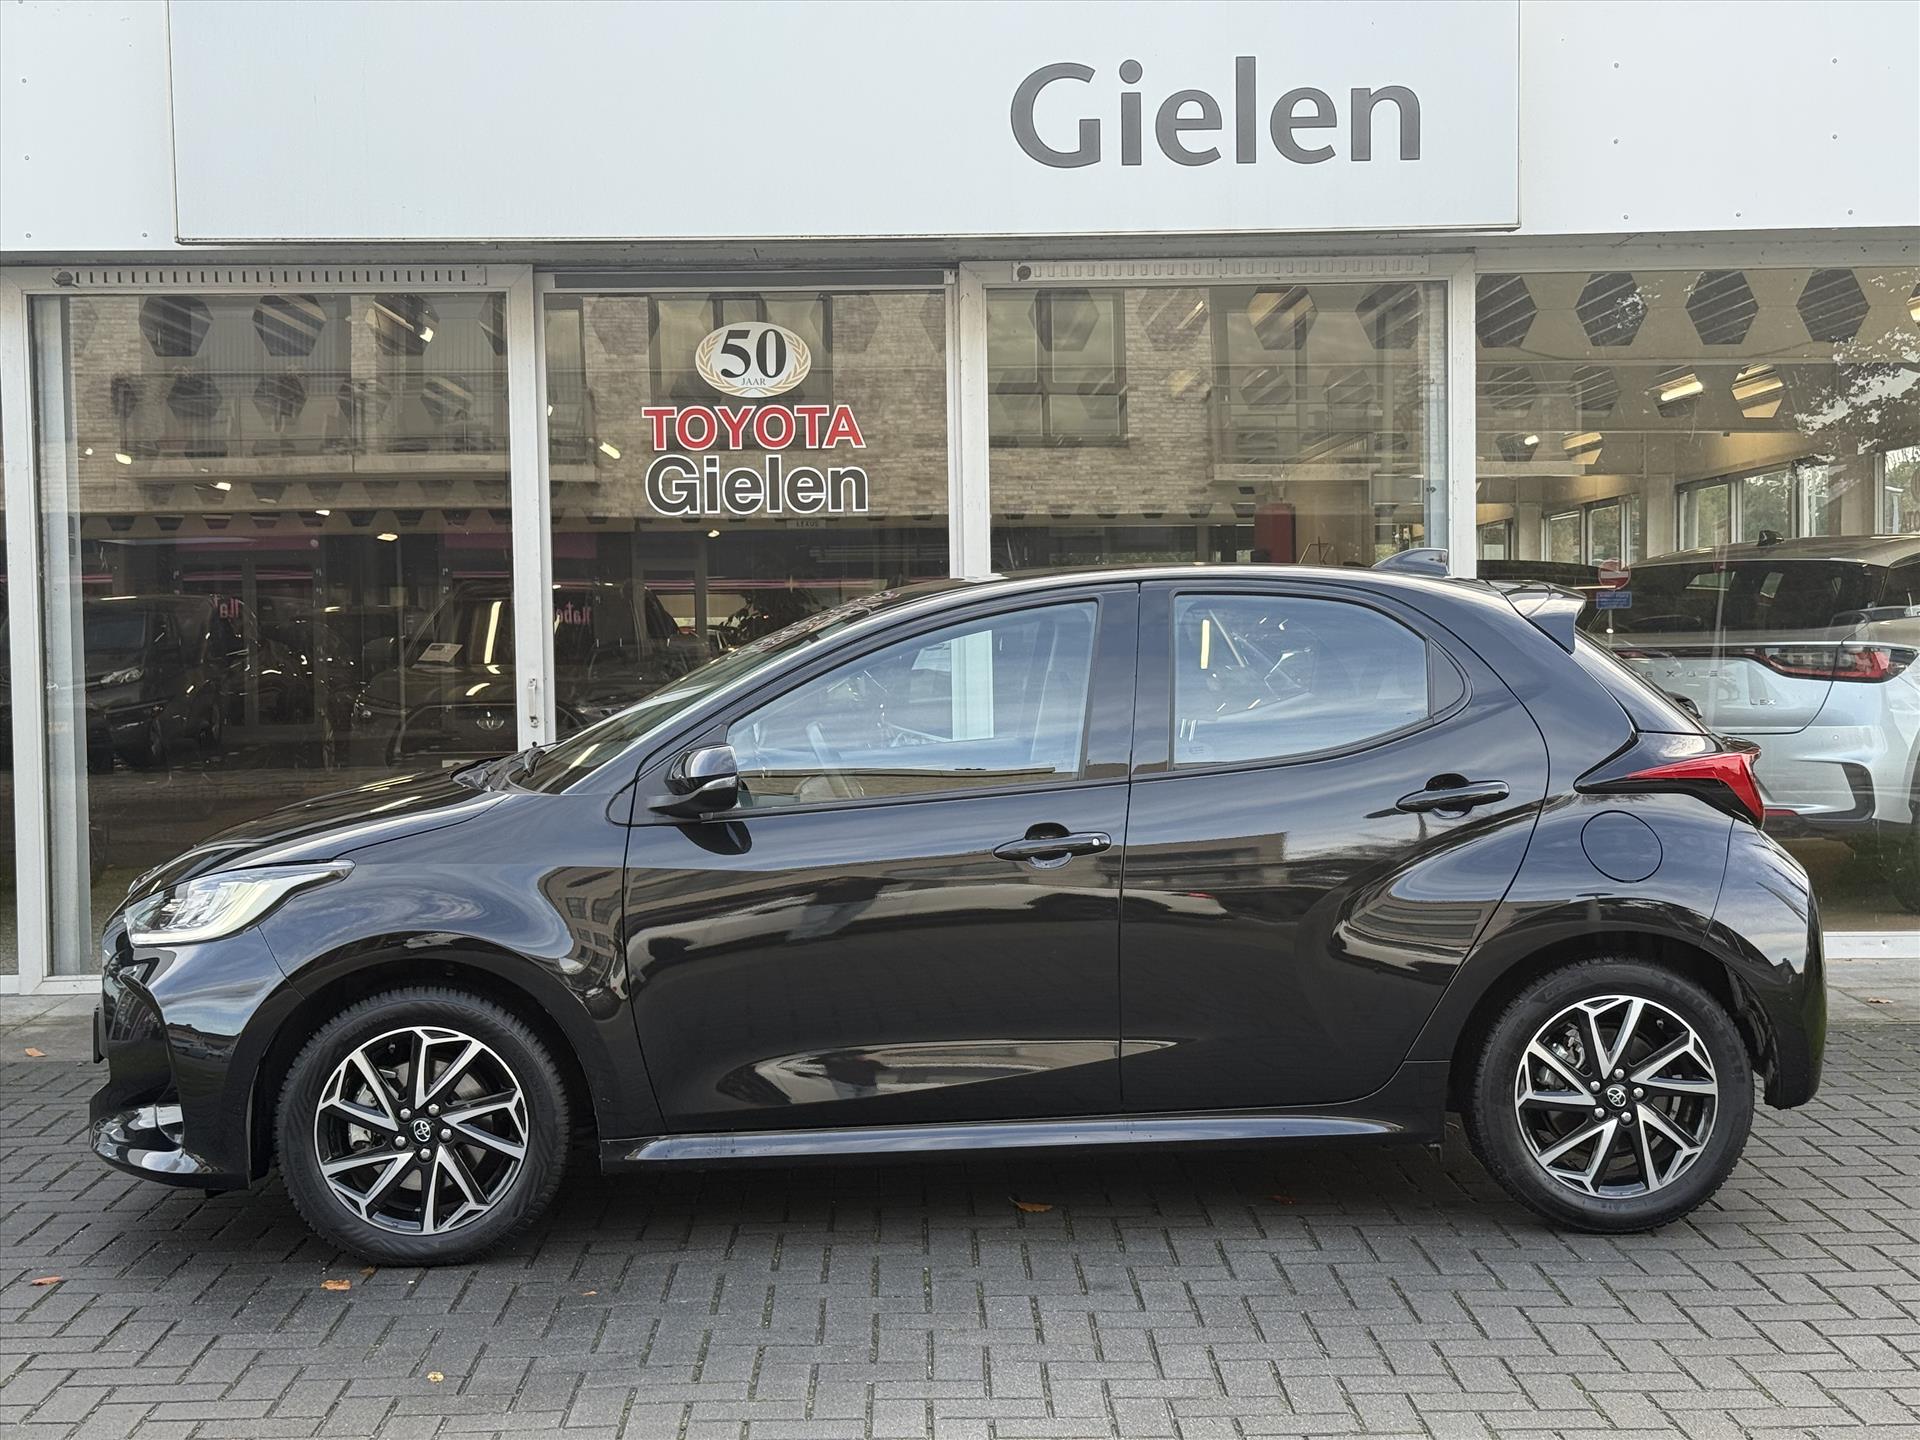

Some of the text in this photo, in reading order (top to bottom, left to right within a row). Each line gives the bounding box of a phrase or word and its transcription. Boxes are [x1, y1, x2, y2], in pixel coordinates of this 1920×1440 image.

[1010, 56, 1420, 169] Gielen
[720, 328, 787, 379] 50
[741, 377, 766, 387] JAAR
[641, 404, 867, 451] TOYOTA
[645, 454, 868, 515] Gielen
